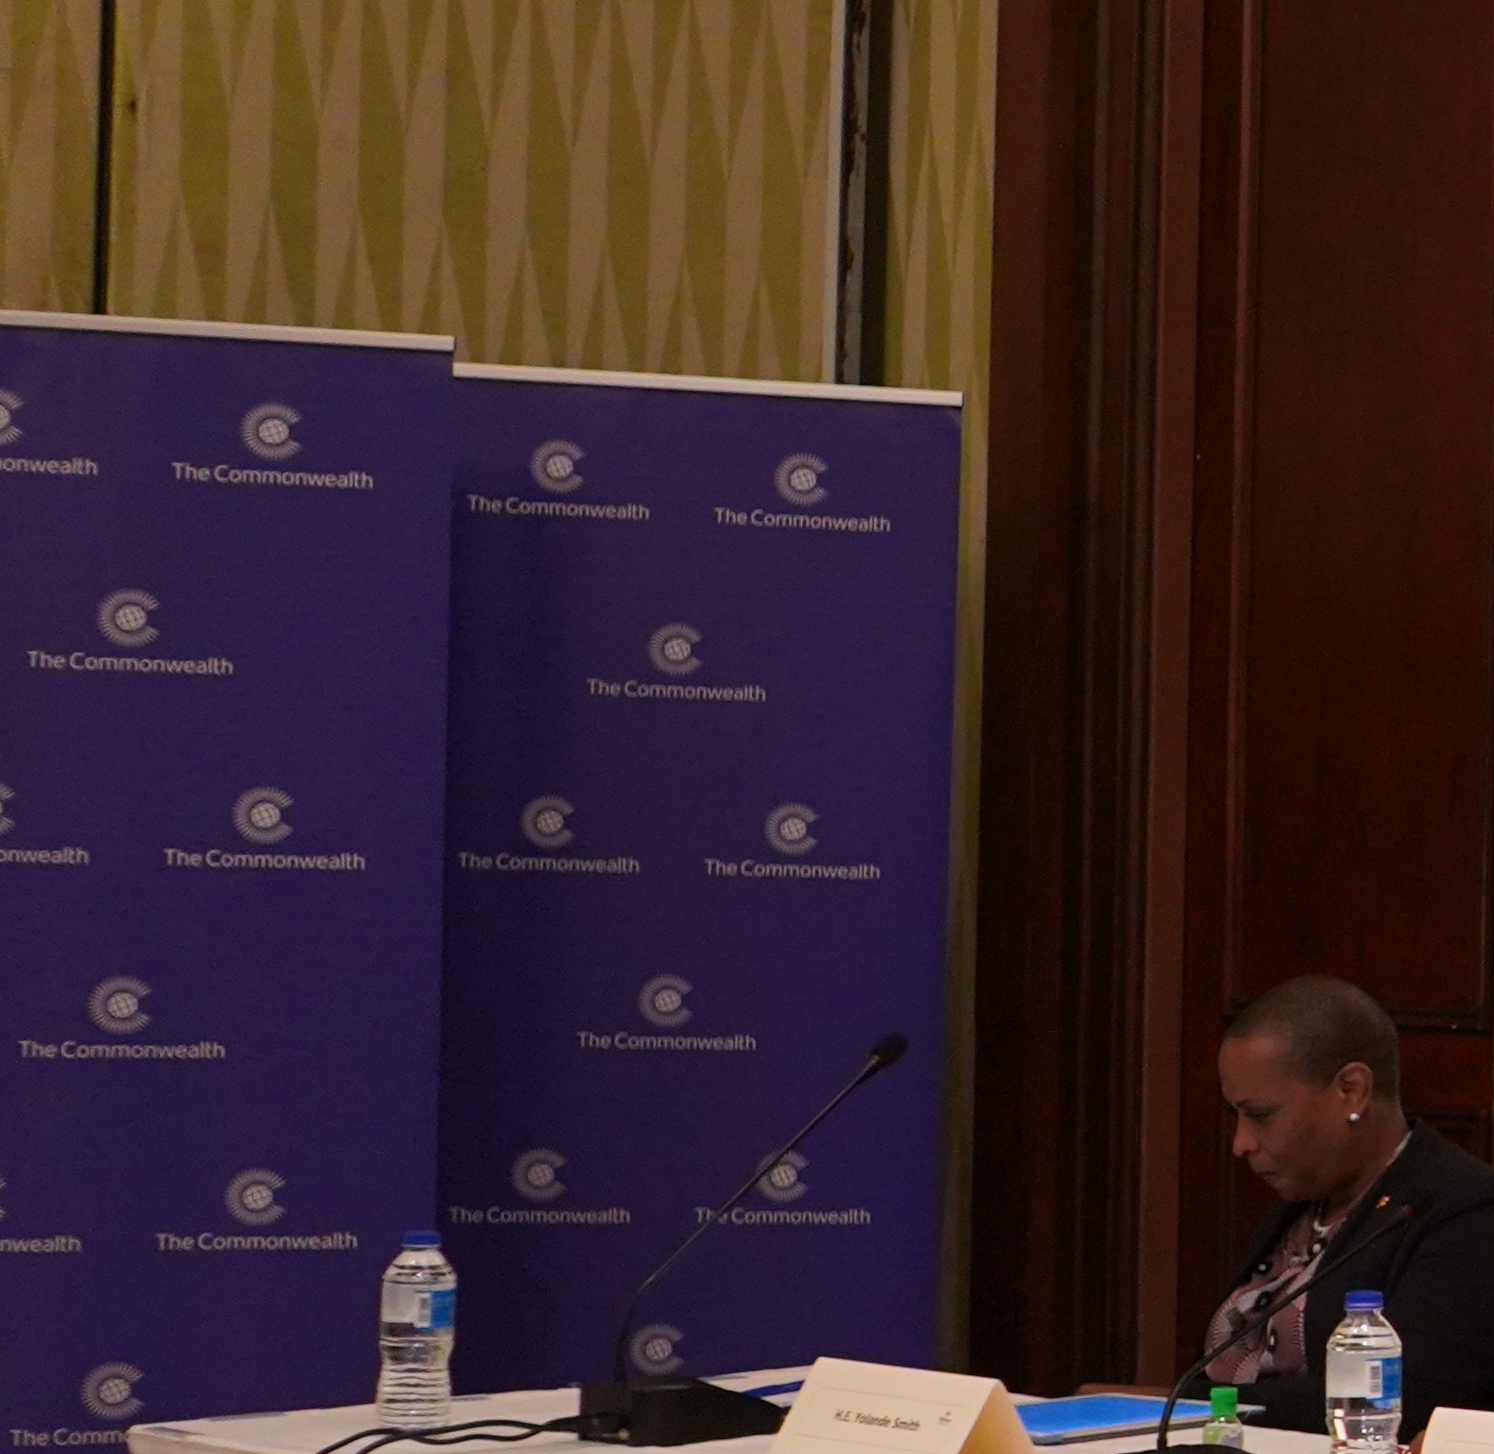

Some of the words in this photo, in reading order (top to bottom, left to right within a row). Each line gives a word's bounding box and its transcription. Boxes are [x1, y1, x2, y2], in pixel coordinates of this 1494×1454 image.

[0, 457, 99, 476] onwealth
[171, 461, 211, 482] The
[212, 464, 374, 489] Commonwealth
[468, 494, 503, 513] The
[505, 497, 651, 521] Commonwealth
[714, 507, 748, 526] The
[750, 508, 891, 533] Commonwealth
[27, 650, 67, 670] The
[68, 652, 234, 676] Commonwealth
[587, 678, 621, 696] The
[623, 679, 767, 702] Commonwealth
[0, 846, 90, 865] onwealth
[163, 847, 203, 867] The
[205, 848, 366, 871] Commonwealth
[459, 852, 493, 869] The
[495, 853, 641, 874] Commonwealth
[704, 858, 738, 876] The
[740, 859, 881, 880] Commonwealth
[18, 1039, 59, 1059] The
[60, 1040, 226, 1059] Commonwealth
[577, 1031, 612, 1049] The
[614, 1032, 757, 1051] Commonwealth
[450, 1207, 484, 1223] The
[486, 1207, 631, 1225] Commonwealth
[731, 1207, 871, 1225] Commonwealth
[0, 1235, 82, 1253] nwealth
[155, 1232, 195, 1251] The
[197, 1232, 358, 1251] Commonwealth
[9, 1427, 51, 1447] The
